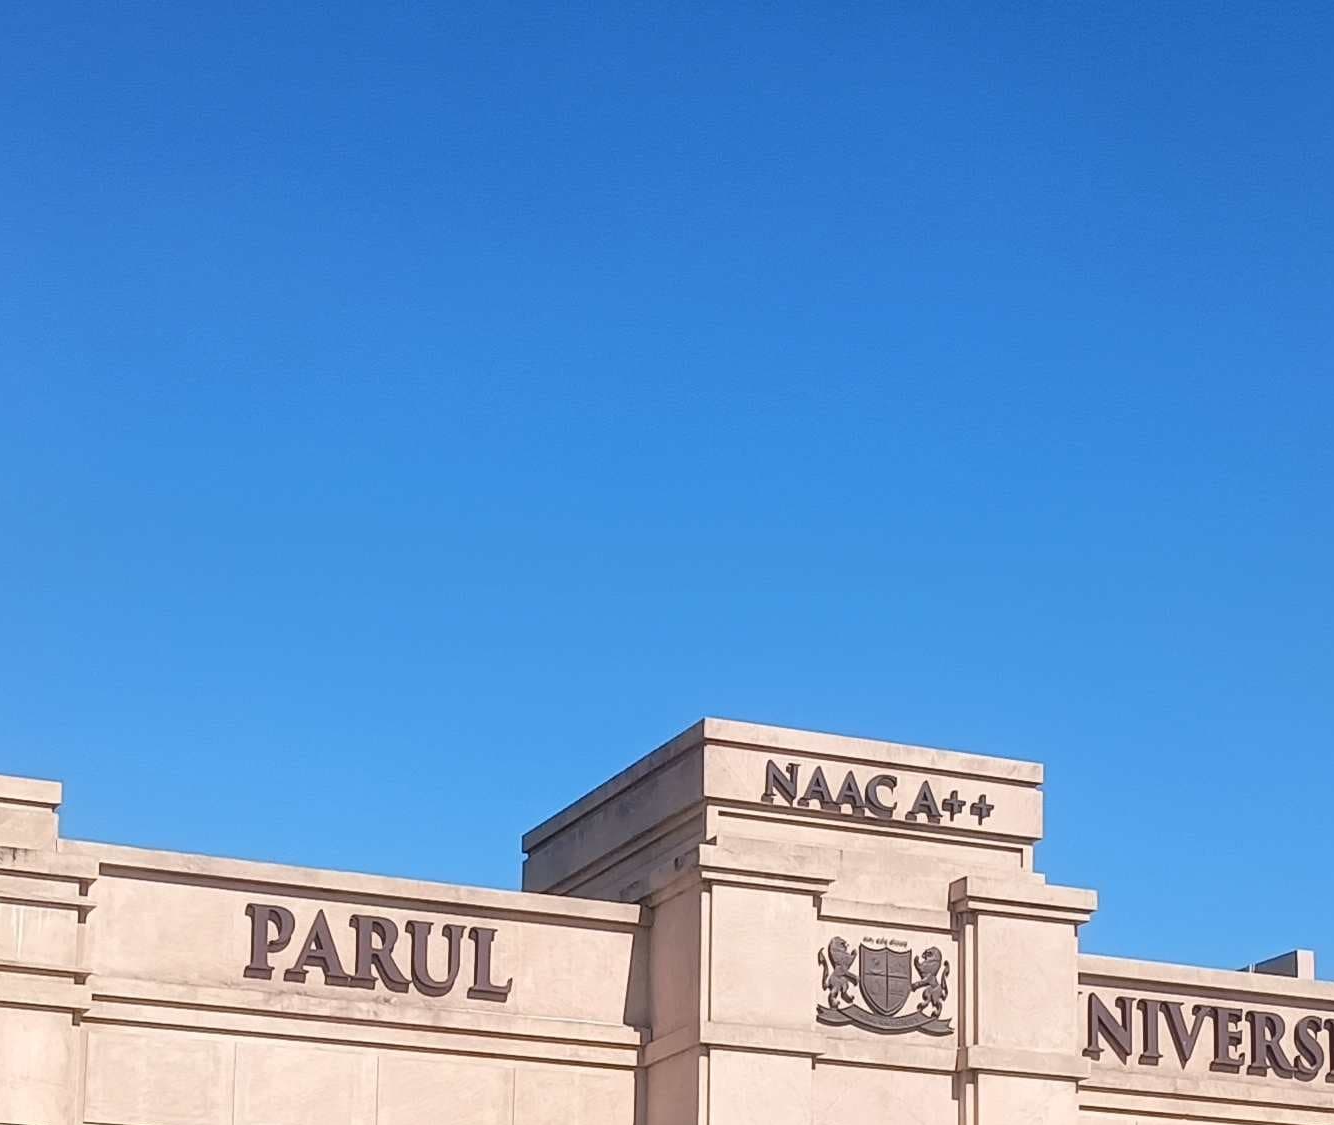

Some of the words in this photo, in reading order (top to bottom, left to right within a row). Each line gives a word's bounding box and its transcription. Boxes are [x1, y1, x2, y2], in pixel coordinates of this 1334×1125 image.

[761, 759, 898, 818] NAAC
[905, 780, 995, 826] A++
[243, 903, 513, 1003] PARUL
